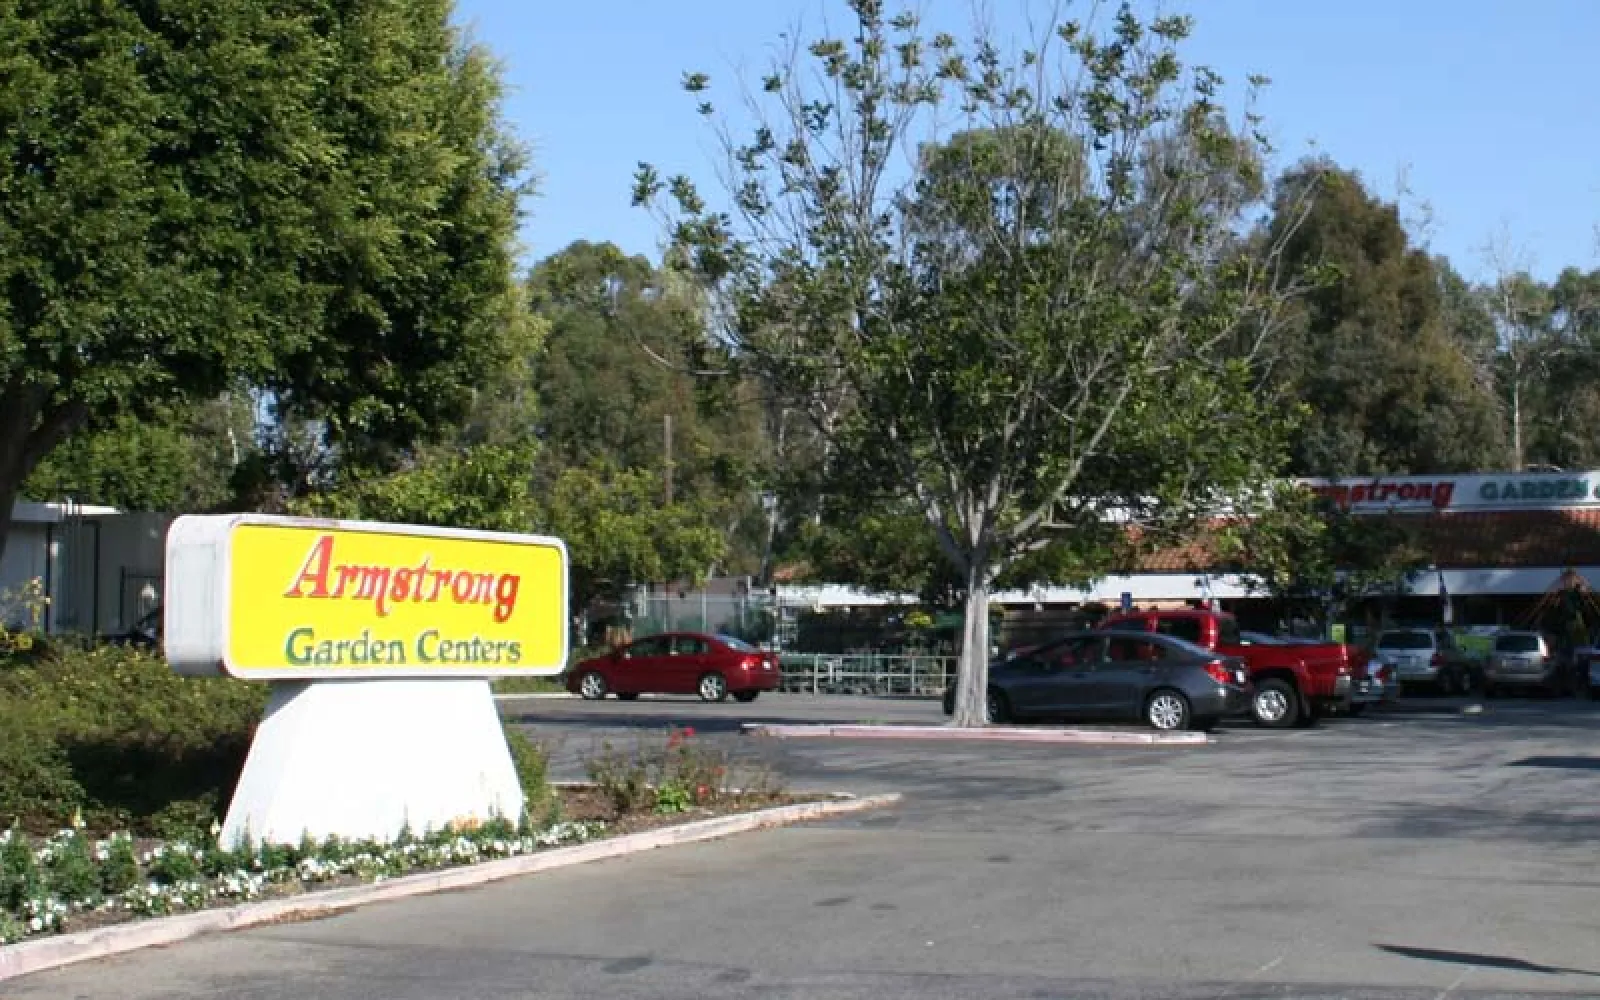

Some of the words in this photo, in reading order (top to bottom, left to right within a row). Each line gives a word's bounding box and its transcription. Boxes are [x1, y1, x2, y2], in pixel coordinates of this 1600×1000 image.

[1479, 479, 1588, 500] GARDEN
[284, 535, 520, 623] Armstrong
[286, 630, 406, 665] Garden
[417, 633, 522, 663] Centers
